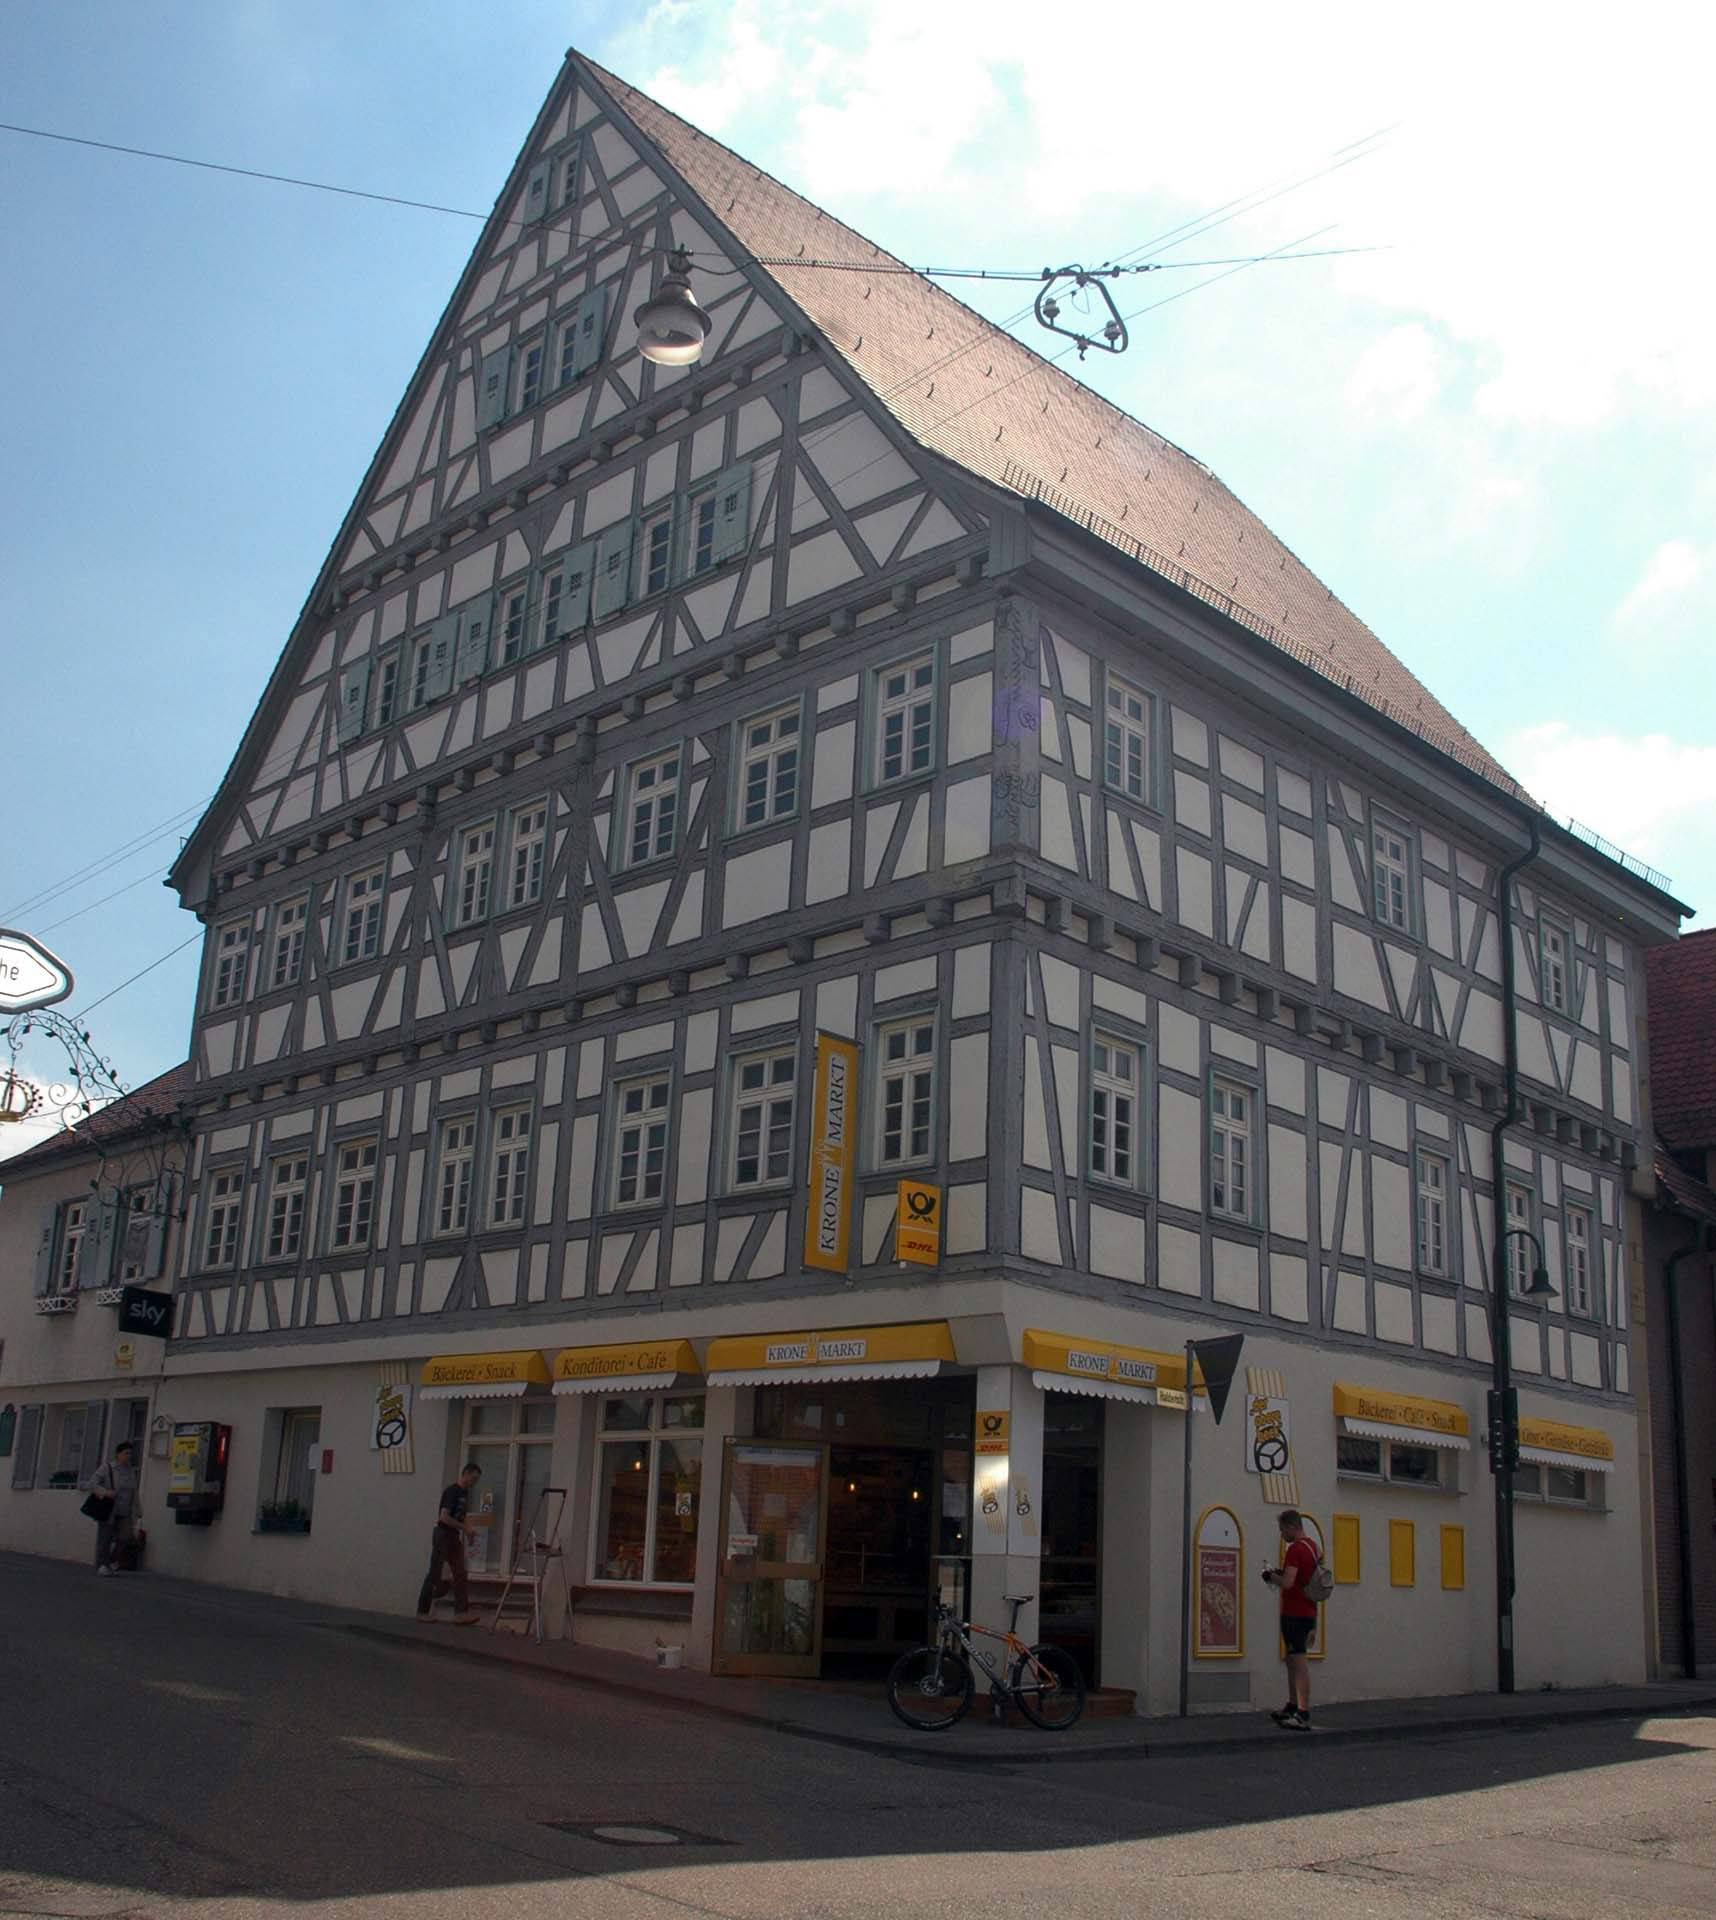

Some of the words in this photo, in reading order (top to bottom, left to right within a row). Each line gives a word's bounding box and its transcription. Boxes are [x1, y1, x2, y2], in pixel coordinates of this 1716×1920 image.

[827, 1056, 845, 1143] MARKT
[820, 1167, 840, 1252] KRONE
[902, 1240, 938, 1253] DHL
[128, 1300, 167, 1327] sky
[562, 1354, 627, 1377] Konditorei
[635, 1351, 668, 1370] Café
[768, 1345, 807, 1361] KRONE
[819, 1342, 866, 1358] MARKT
[432, 1363, 475, 1382] Bäckerei
[485, 1361, 518, 1380] Snack
[1069, 1353, 1106, 1372] KRONE
[1119, 1361, 1155, 1380] MARKT
